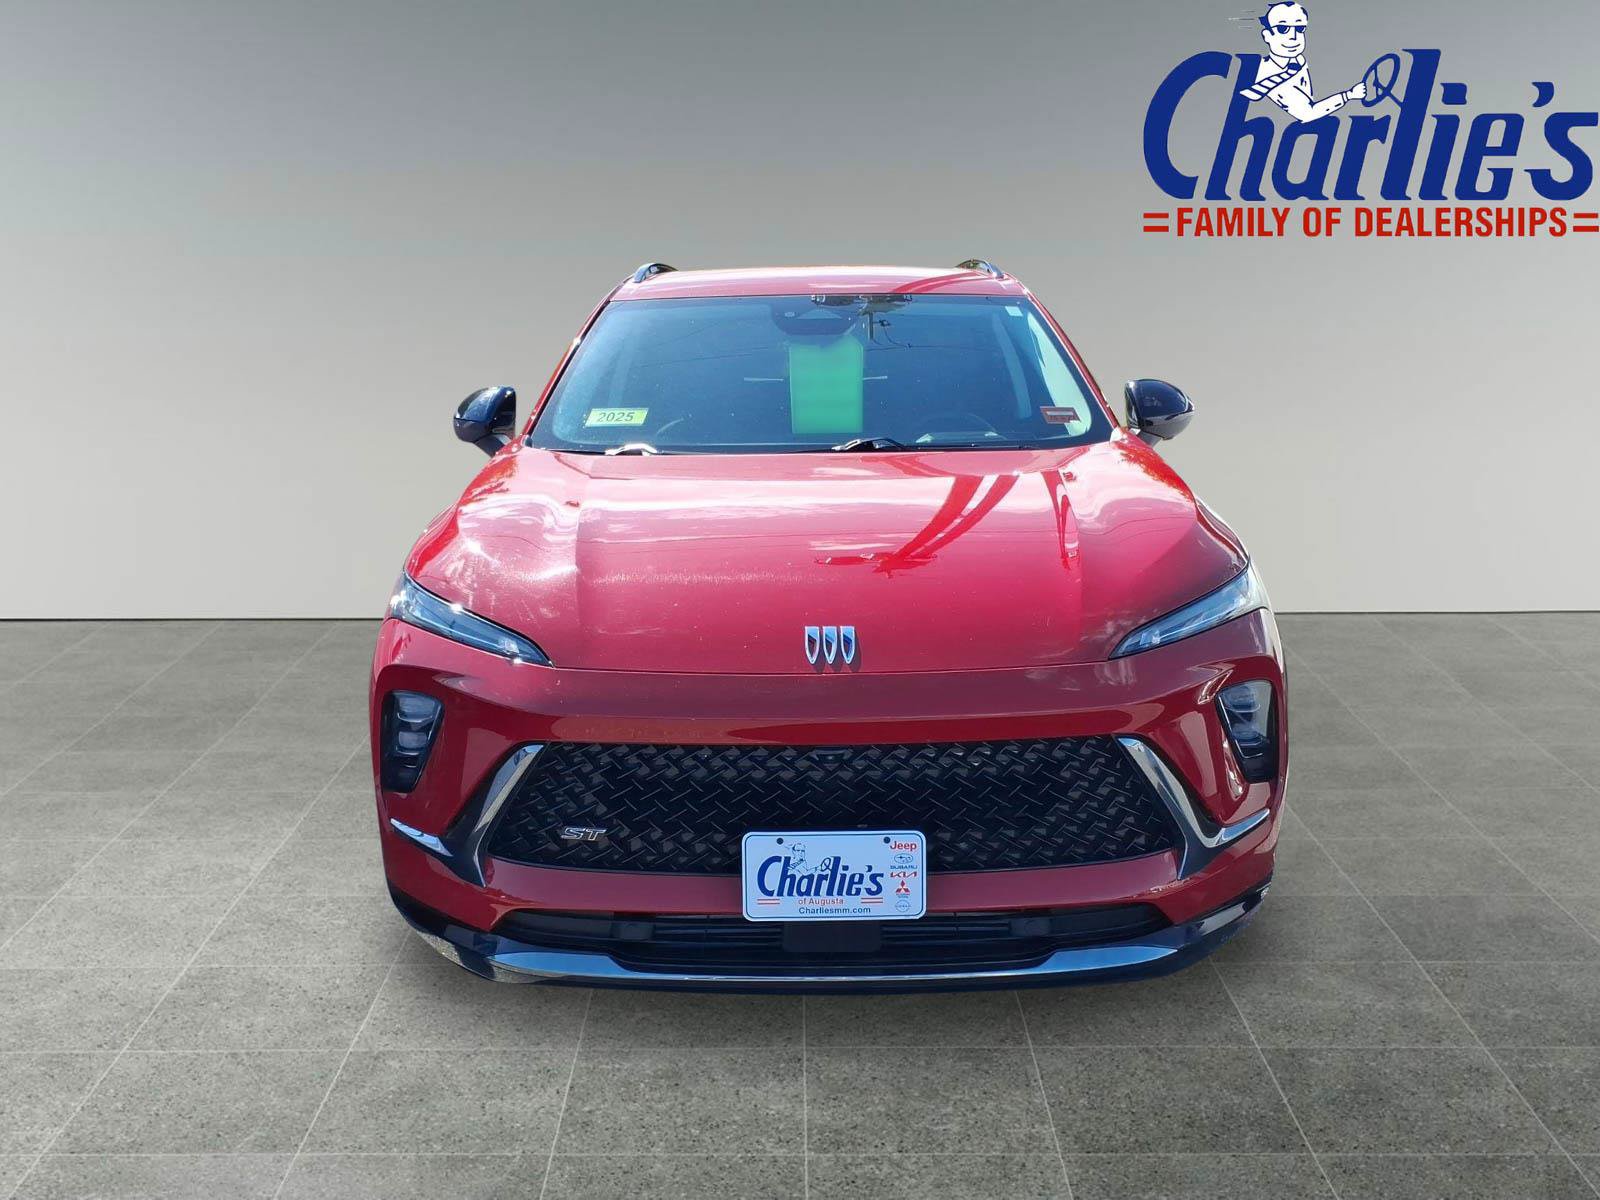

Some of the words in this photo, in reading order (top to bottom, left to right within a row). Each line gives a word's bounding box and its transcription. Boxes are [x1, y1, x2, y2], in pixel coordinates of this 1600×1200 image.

[597, 411, 635, 422] 2025
[561, 827, 607, 841] ST
[890, 840, 917, 851] Jeep
[757, 855, 884, 897] Charlie's
[798, 897, 807, 905] of
[808, 897, 844, 906] Augusta
[798, 906, 871, 915] Charliesmm.com
